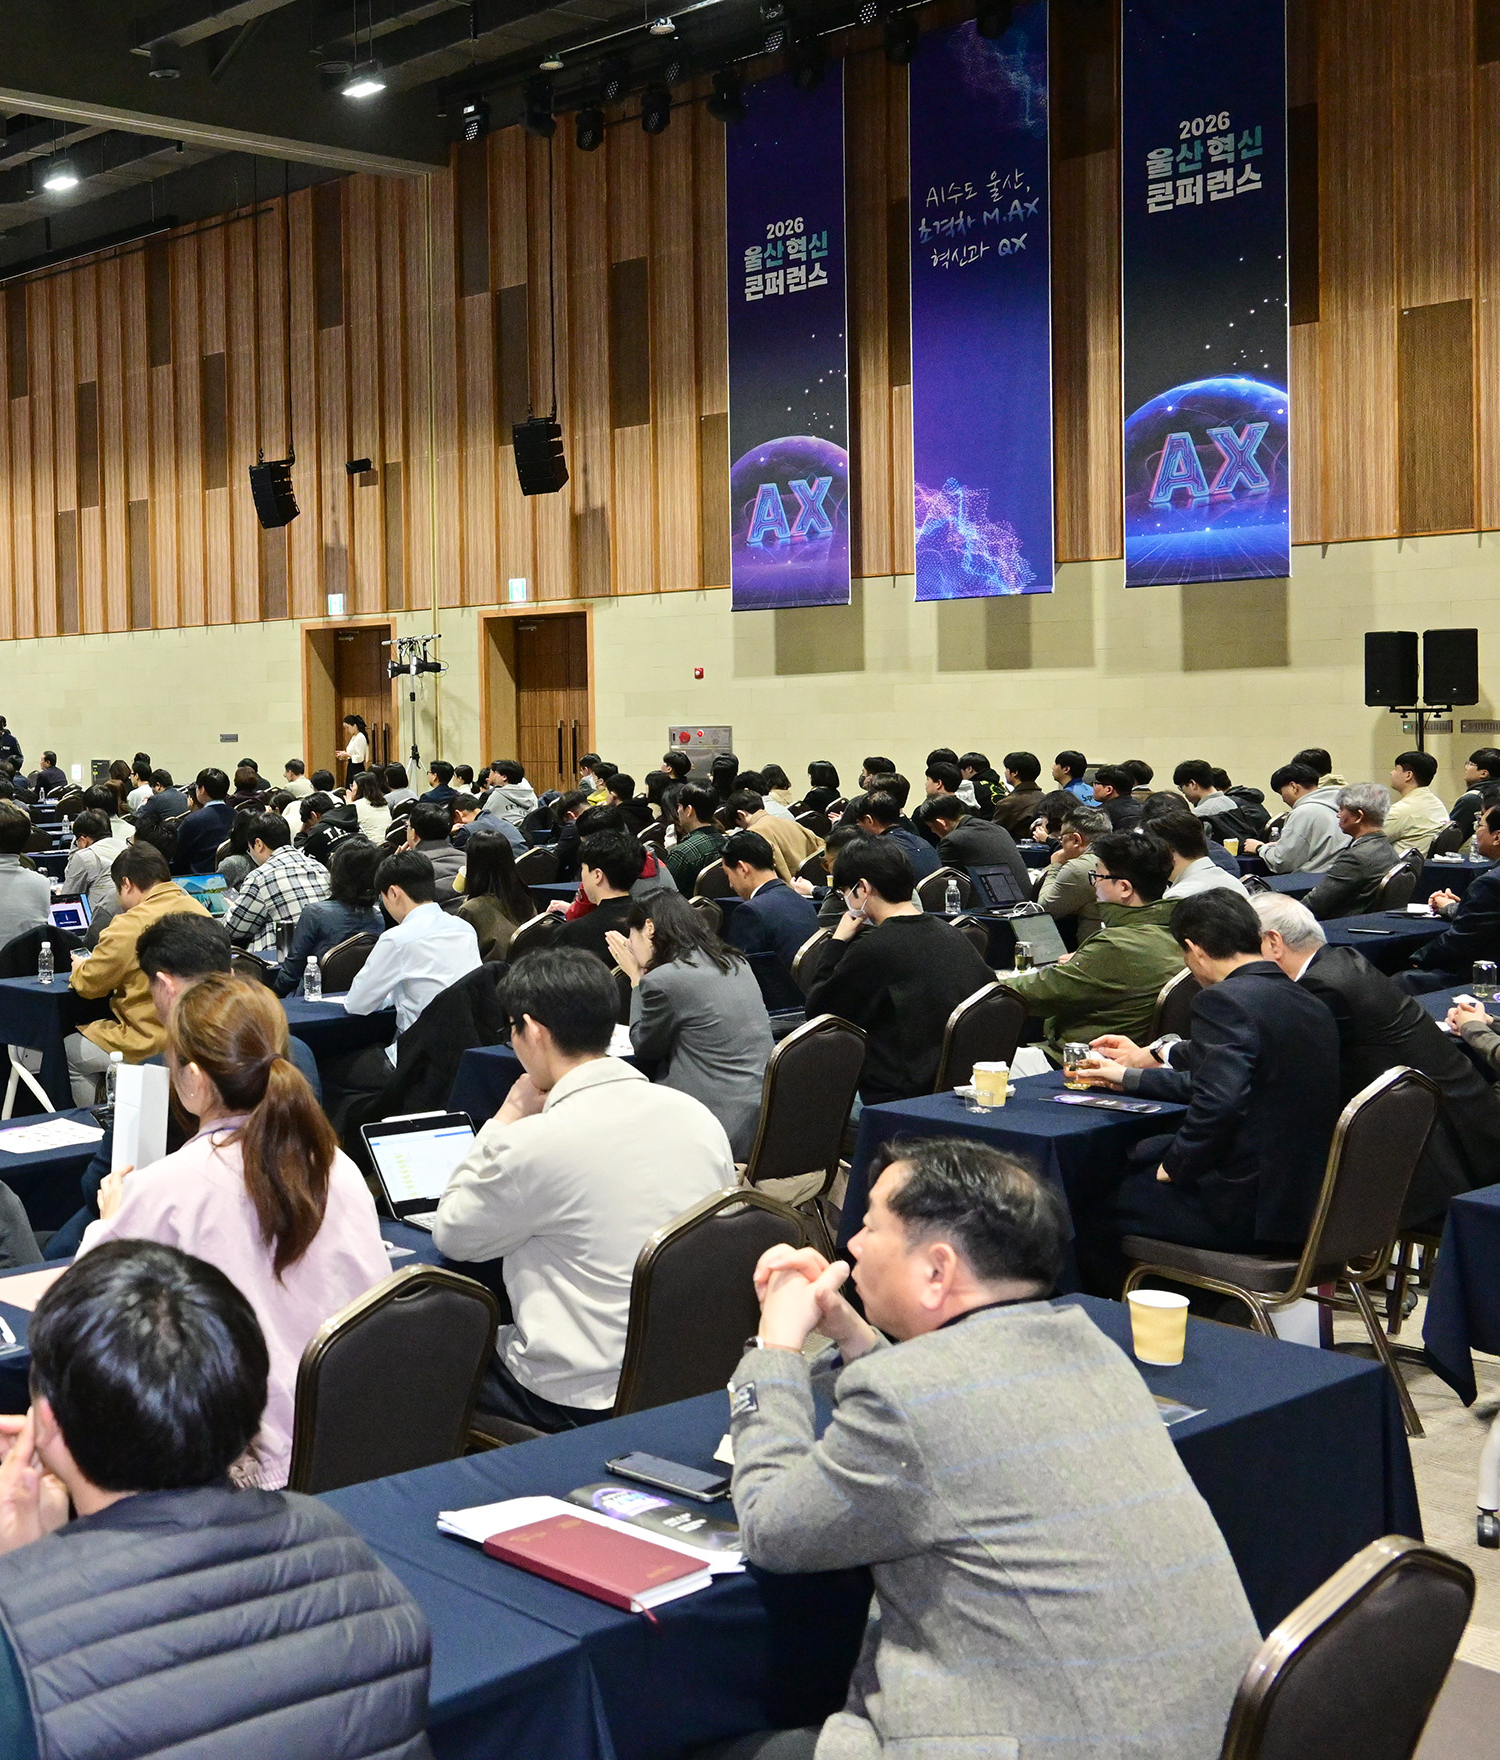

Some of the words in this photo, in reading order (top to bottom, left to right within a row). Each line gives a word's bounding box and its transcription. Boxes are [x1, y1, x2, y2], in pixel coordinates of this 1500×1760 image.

[1179, 110, 1231, 140] 2026
[925, 182, 978, 208] AI수도
[986, 168, 1031, 203] 울산,
[1146, 163, 1263, 214] 콘퍼런스
[766, 216, 805, 240] 2026
[918, 210, 977, 244] 초격차
[983, 197, 1040, 226] M.AX
[930, 241, 991, 270] 혁신과
[998, 233, 1028, 257] QX
[744, 262, 829, 302] 콘퍼런스
[1148, 421, 1270, 503] AX
[746, 476, 833, 543] AX
